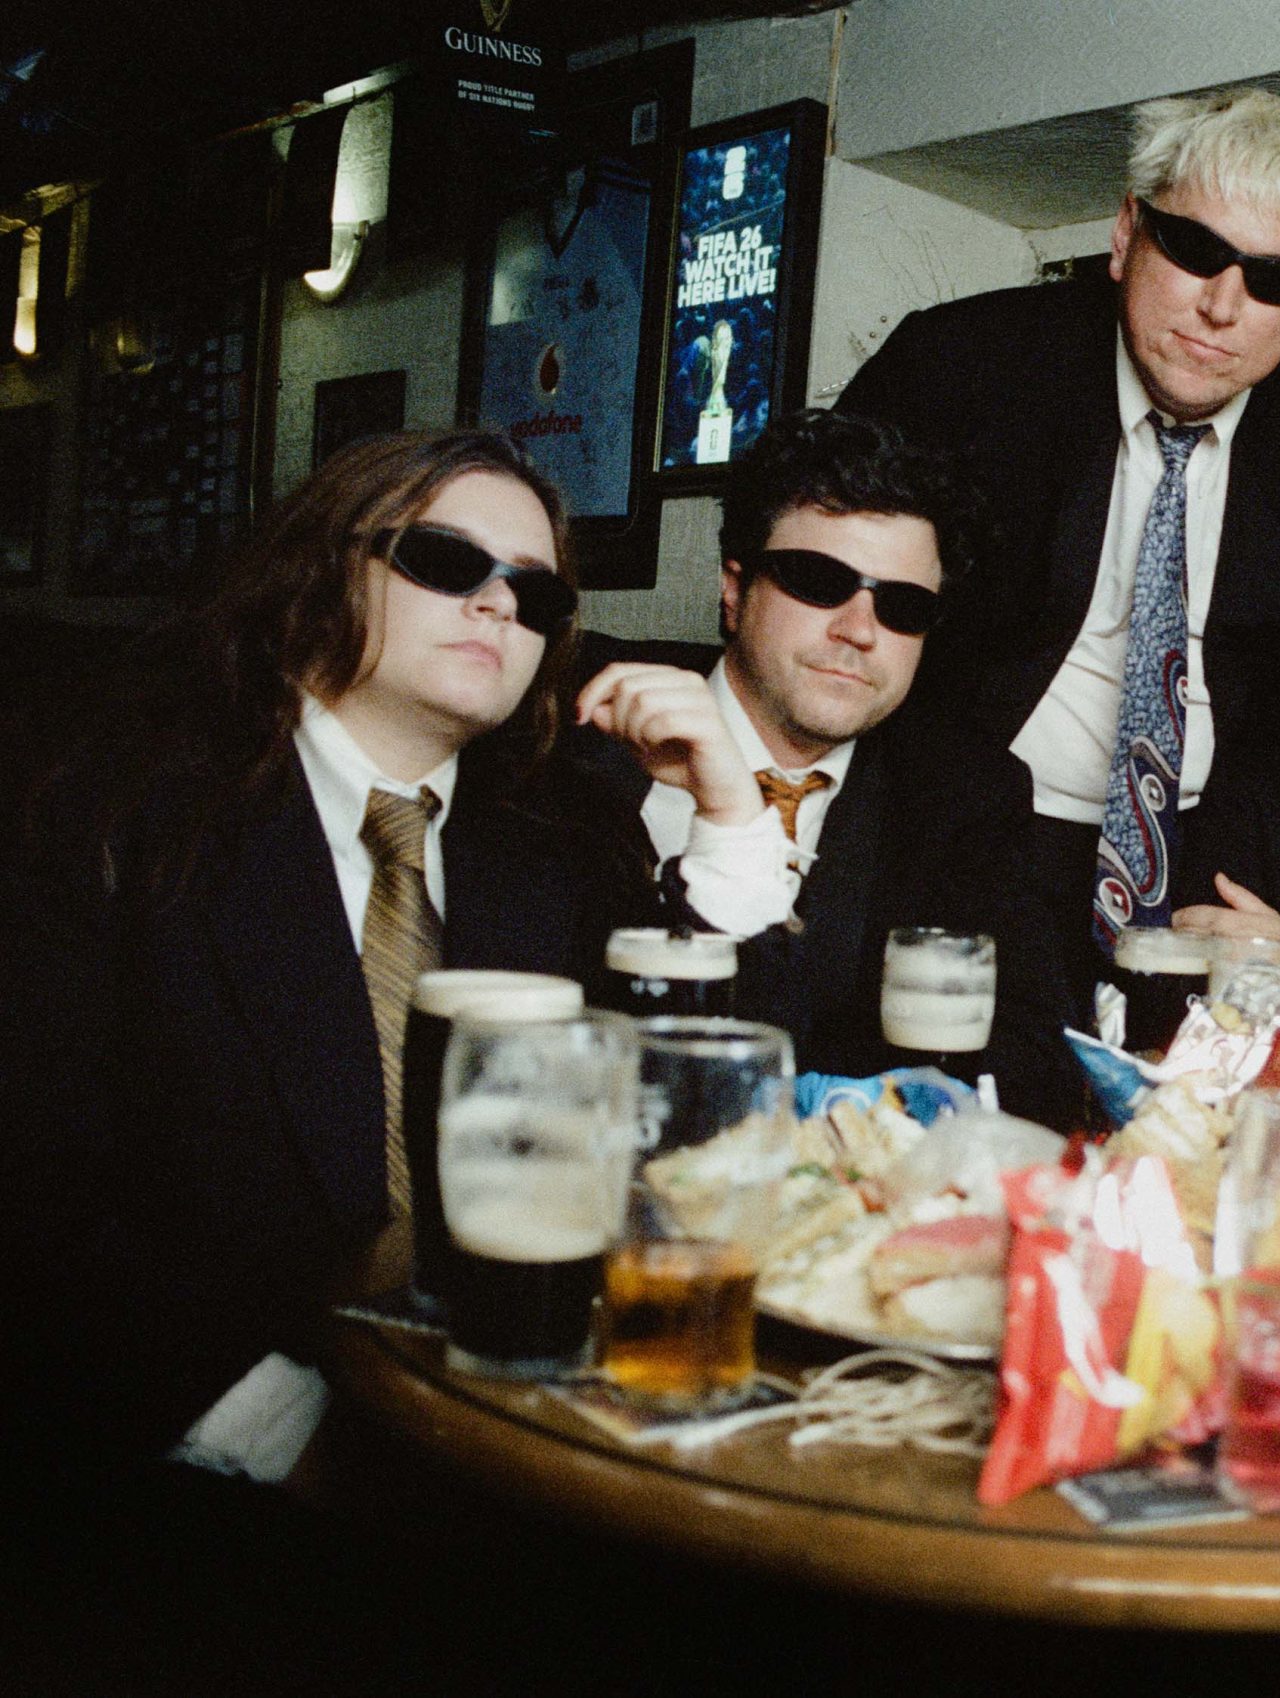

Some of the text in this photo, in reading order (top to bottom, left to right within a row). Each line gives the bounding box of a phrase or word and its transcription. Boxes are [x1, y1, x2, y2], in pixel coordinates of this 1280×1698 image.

[444, 27, 542, 67] GUINNESS
[697, 225, 762, 260] FIFA 26
[684, 245, 774, 285] WATCH IT
[677, 267, 777, 309] HERE LIVE!
